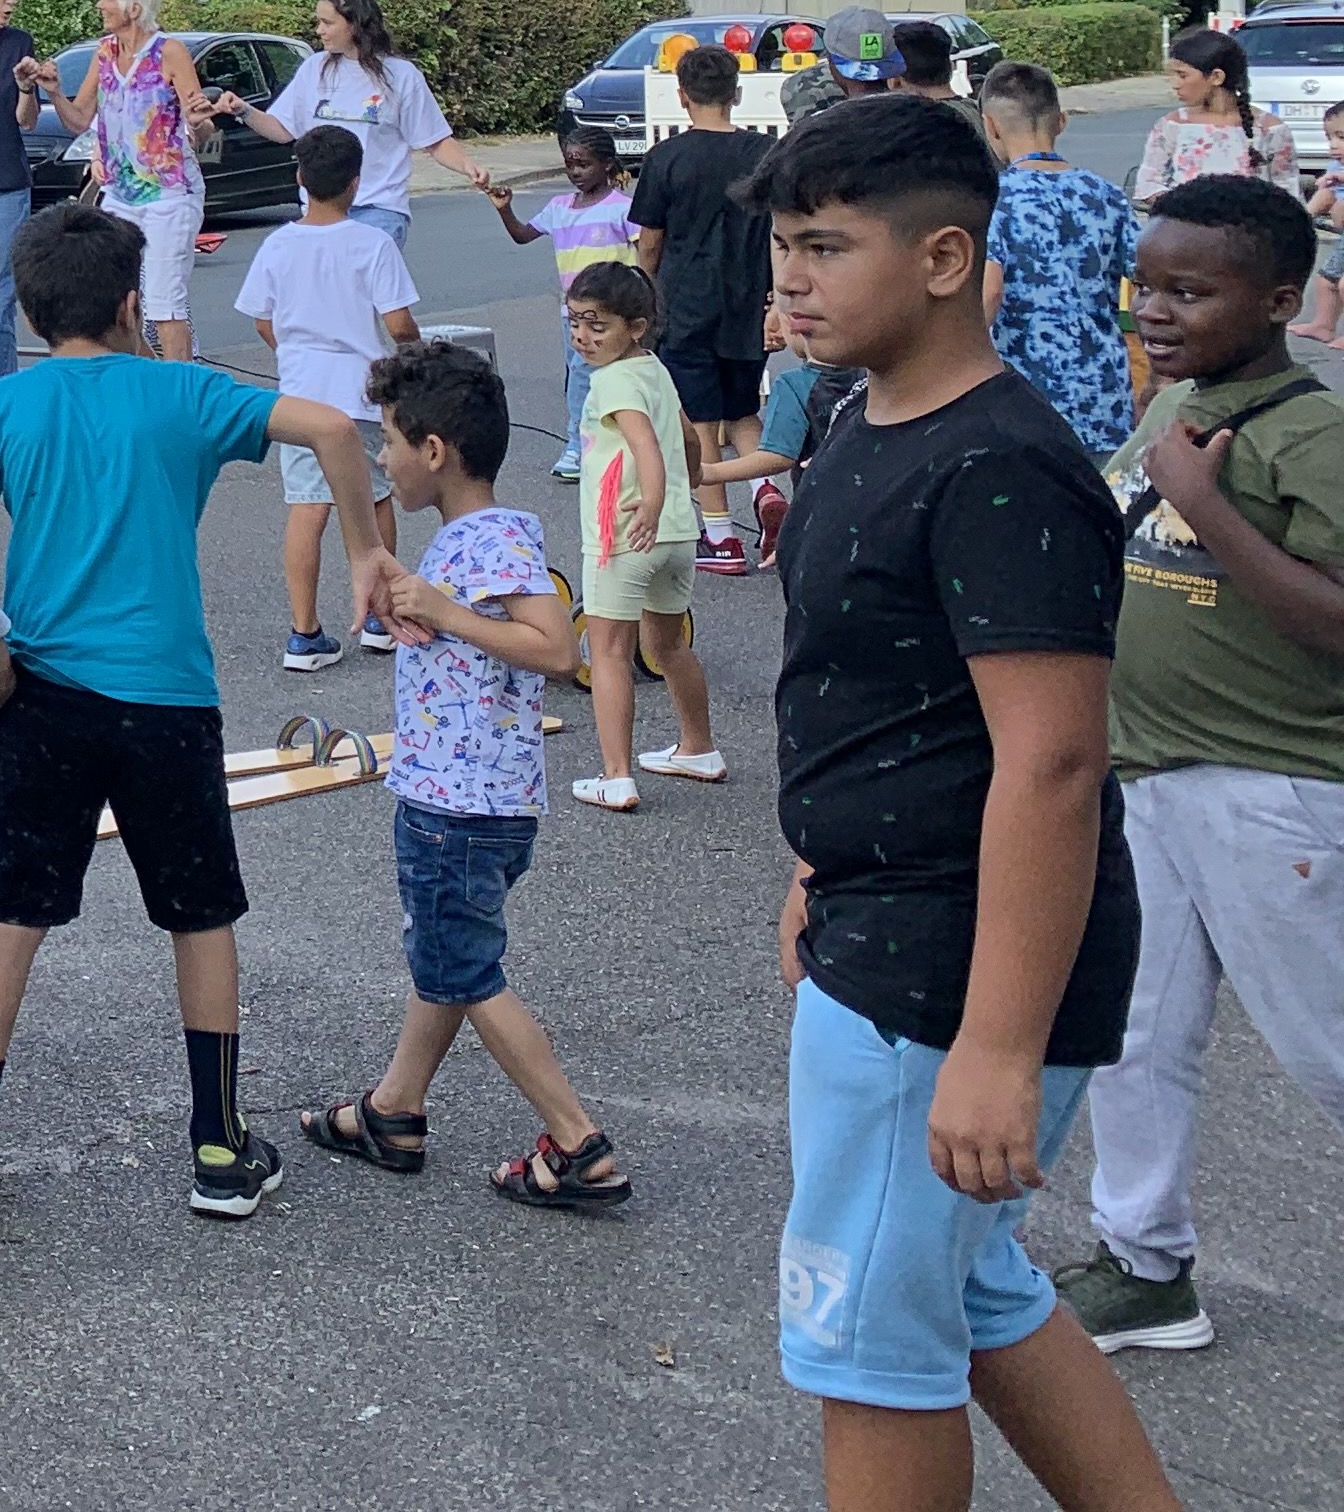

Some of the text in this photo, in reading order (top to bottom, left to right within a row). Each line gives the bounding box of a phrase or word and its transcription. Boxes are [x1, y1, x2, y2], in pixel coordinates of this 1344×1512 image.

[865, 36, 879, 46] LA
[1154, 569, 1218, 588] BOROUGHS
[780, 1256, 848, 1327] 97
